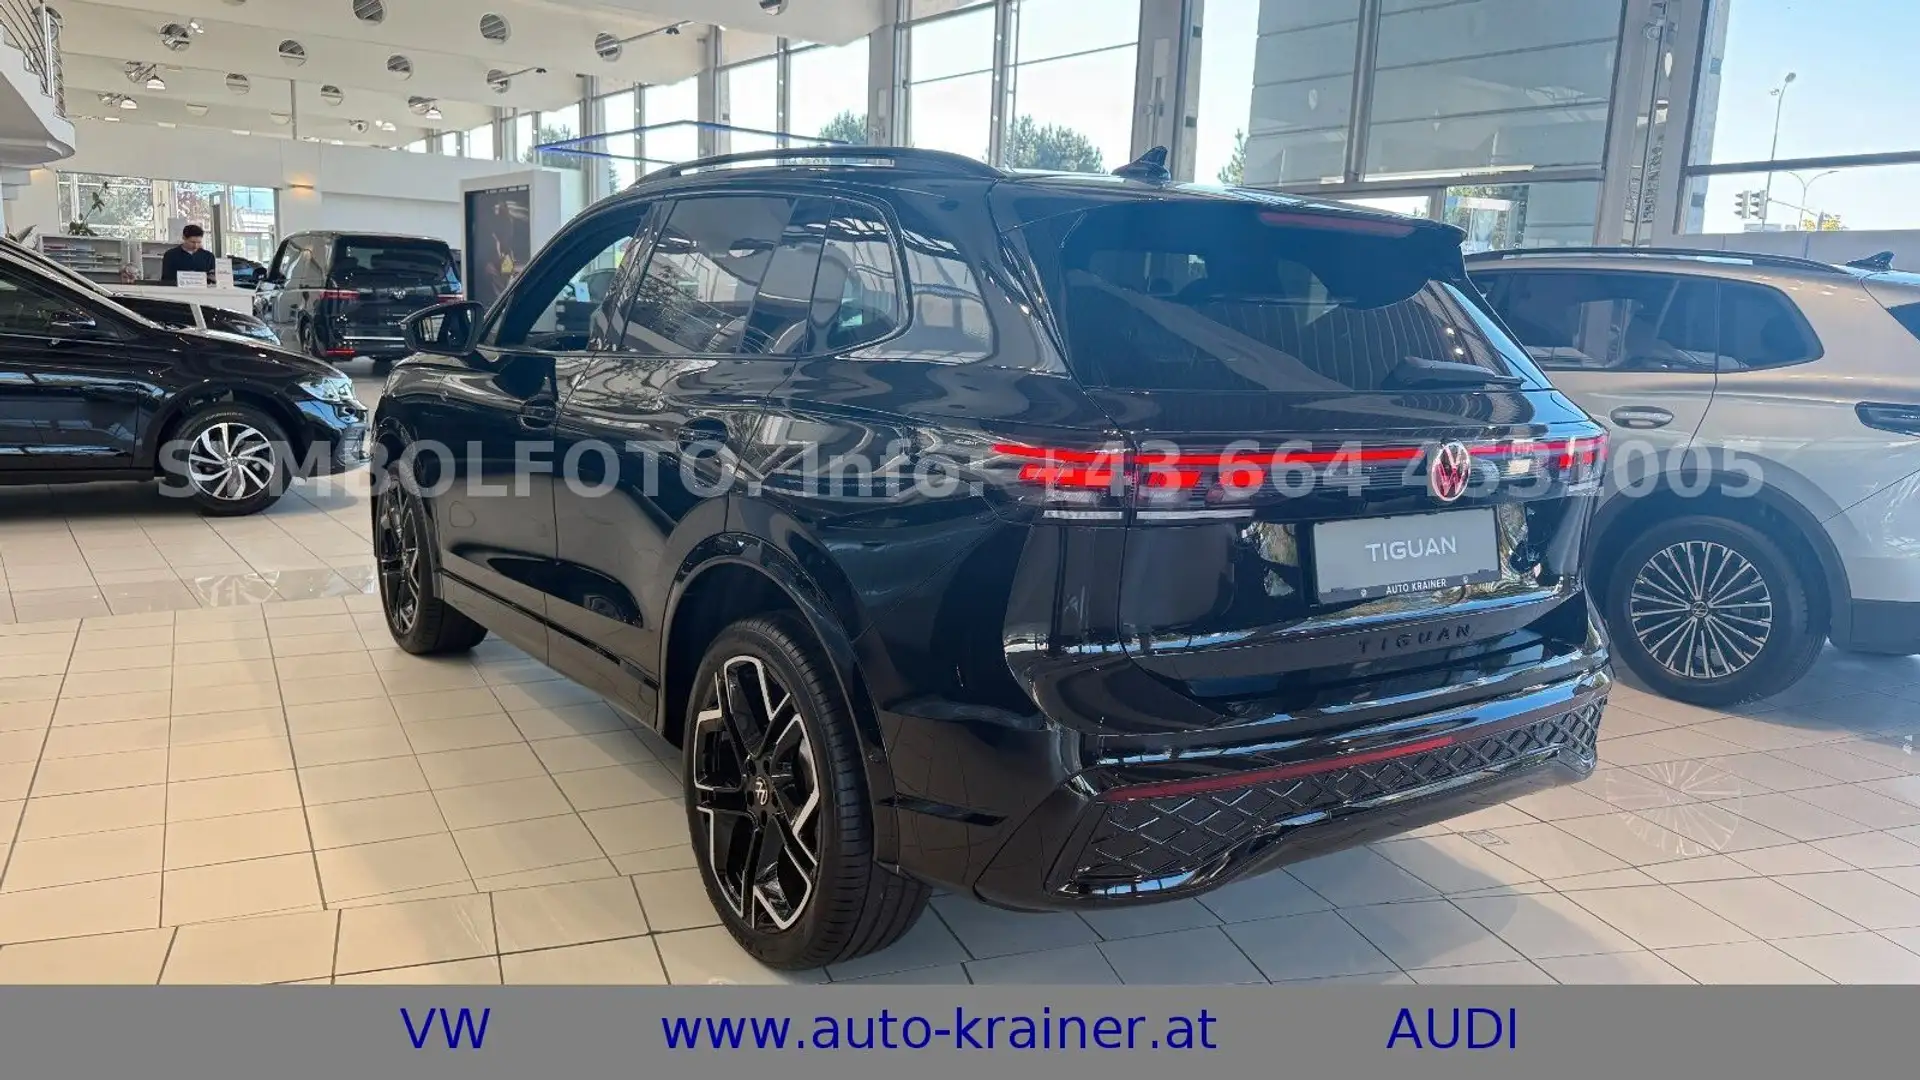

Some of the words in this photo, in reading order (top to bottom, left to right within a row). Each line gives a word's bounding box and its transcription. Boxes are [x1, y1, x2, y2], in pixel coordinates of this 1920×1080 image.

[1365, 536, 1457, 562] TIGUAN
[1385, 584, 1409, 595] AUTO
[1411, 578, 1447, 592] KRAINER
[1359, 624, 1470, 654] TIGUAN
